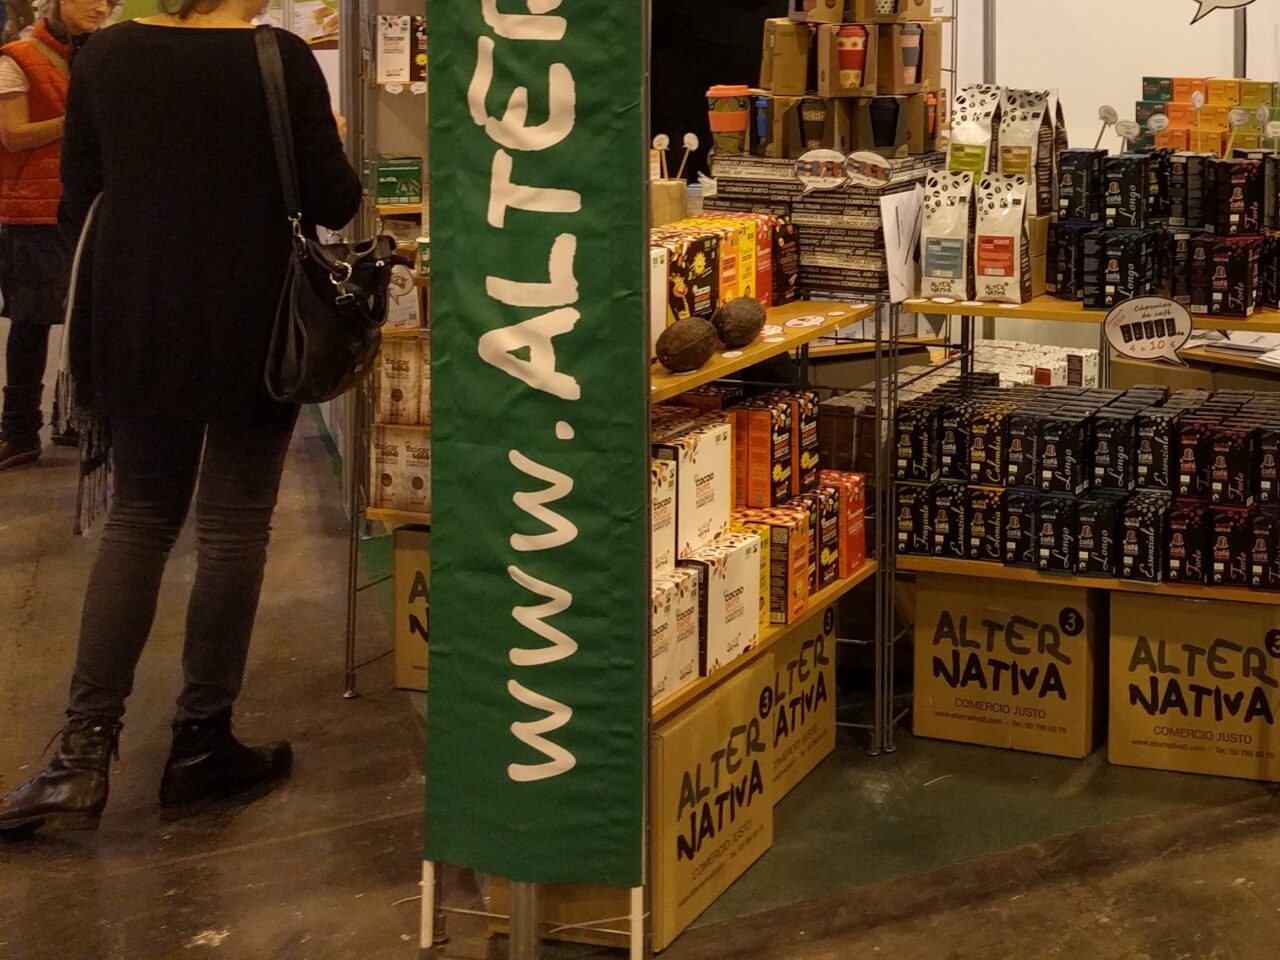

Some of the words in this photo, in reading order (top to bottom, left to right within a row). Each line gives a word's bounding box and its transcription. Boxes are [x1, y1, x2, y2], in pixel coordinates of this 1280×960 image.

[1118, 184, 1141, 226] Longo
[1054, 448, 1077, 491] Longo
[1106, 445, 1129, 487] Longo
[1052, 527, 1075, 569] Longo
[1090, 529, 1113, 571] Longo
[932, 610, 1072, 665] ALTER
[1128, 635, 1280, 688] ALTER
[773, 633, 830, 707] LTER
[932, 649, 1067, 701] NATIVA
[773, 670, 828, 750] ATIVA
[954, 697, 1010, 714] COMERCIO
[1014, 705, 1047, 719] JUSTO
[1128, 675, 1274, 725] NATIVA
[1153, 725, 1214, 741] COMERCIO
[1217, 731, 1253, 745] JUSTO
[676, 717, 766, 823] ALTER
[676, 759, 764, 862] NATIVA
